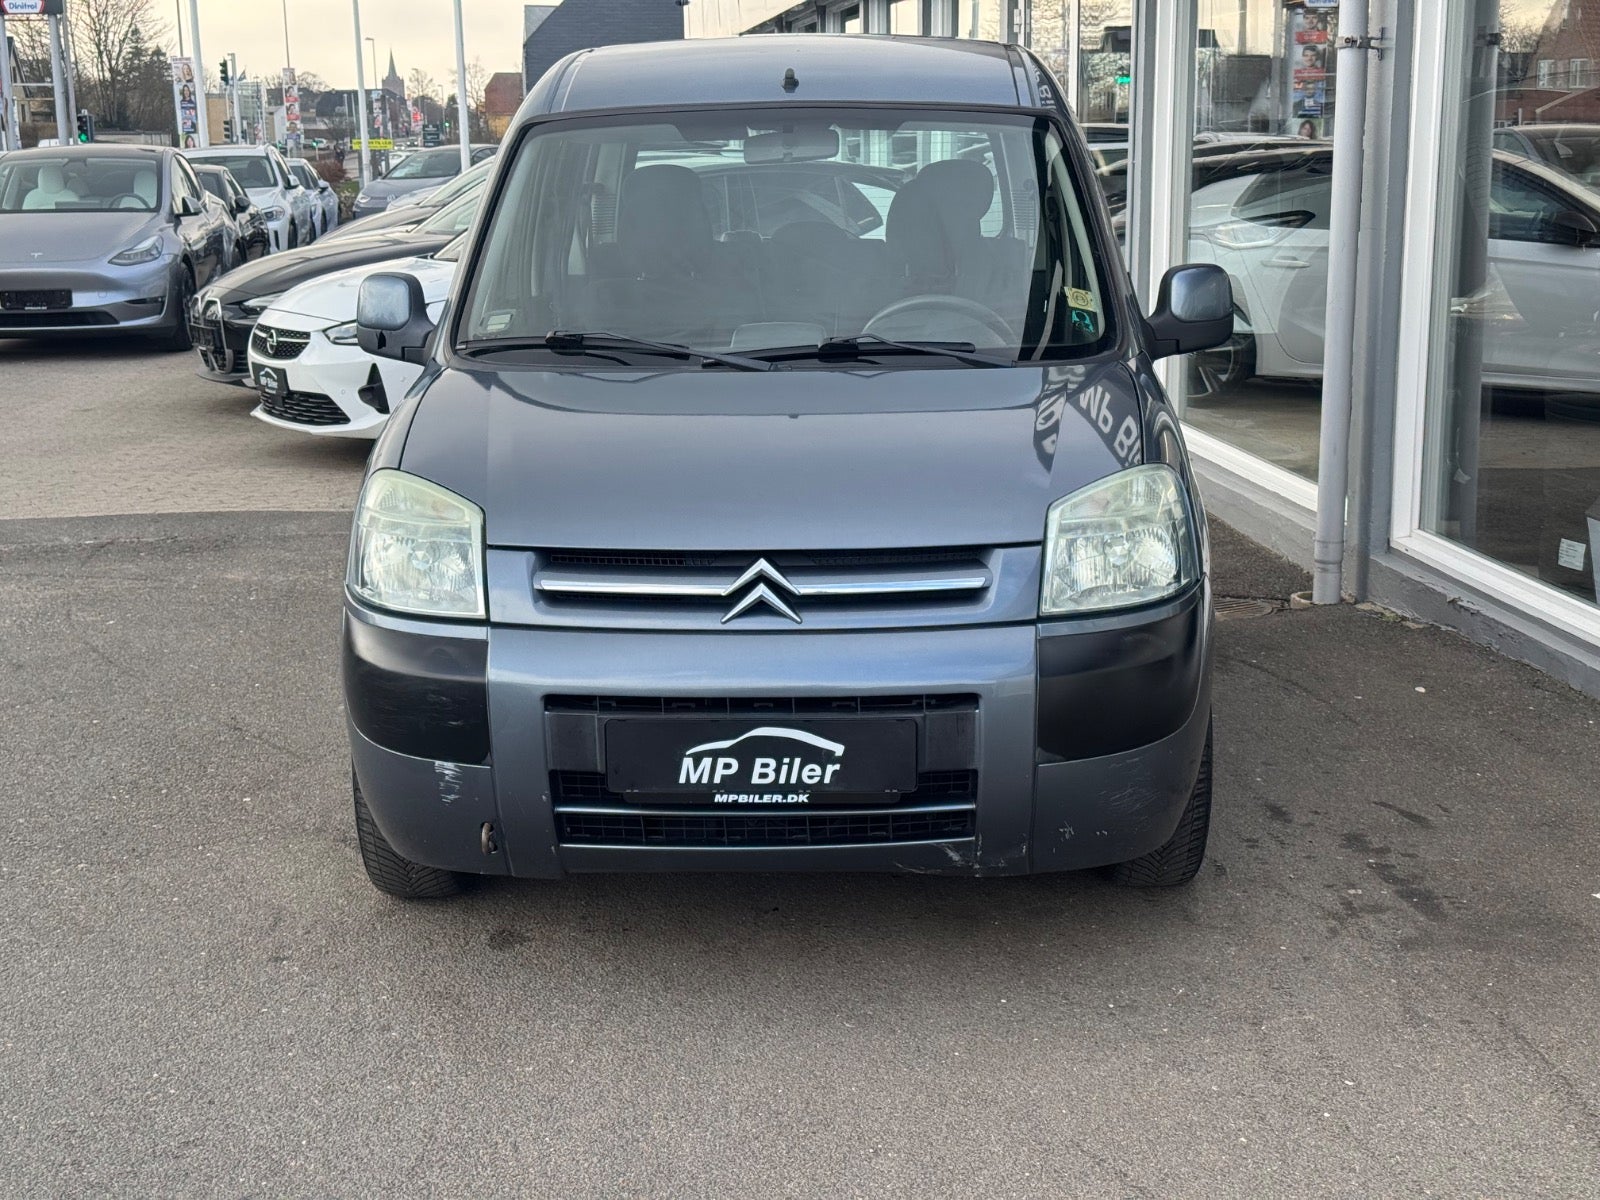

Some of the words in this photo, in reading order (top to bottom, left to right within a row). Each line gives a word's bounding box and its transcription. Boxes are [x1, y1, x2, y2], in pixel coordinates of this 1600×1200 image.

[678, 757, 739, 784] MP
[751, 757, 841, 784] Biler
[714, 793, 810, 803] MPBILER.DK
